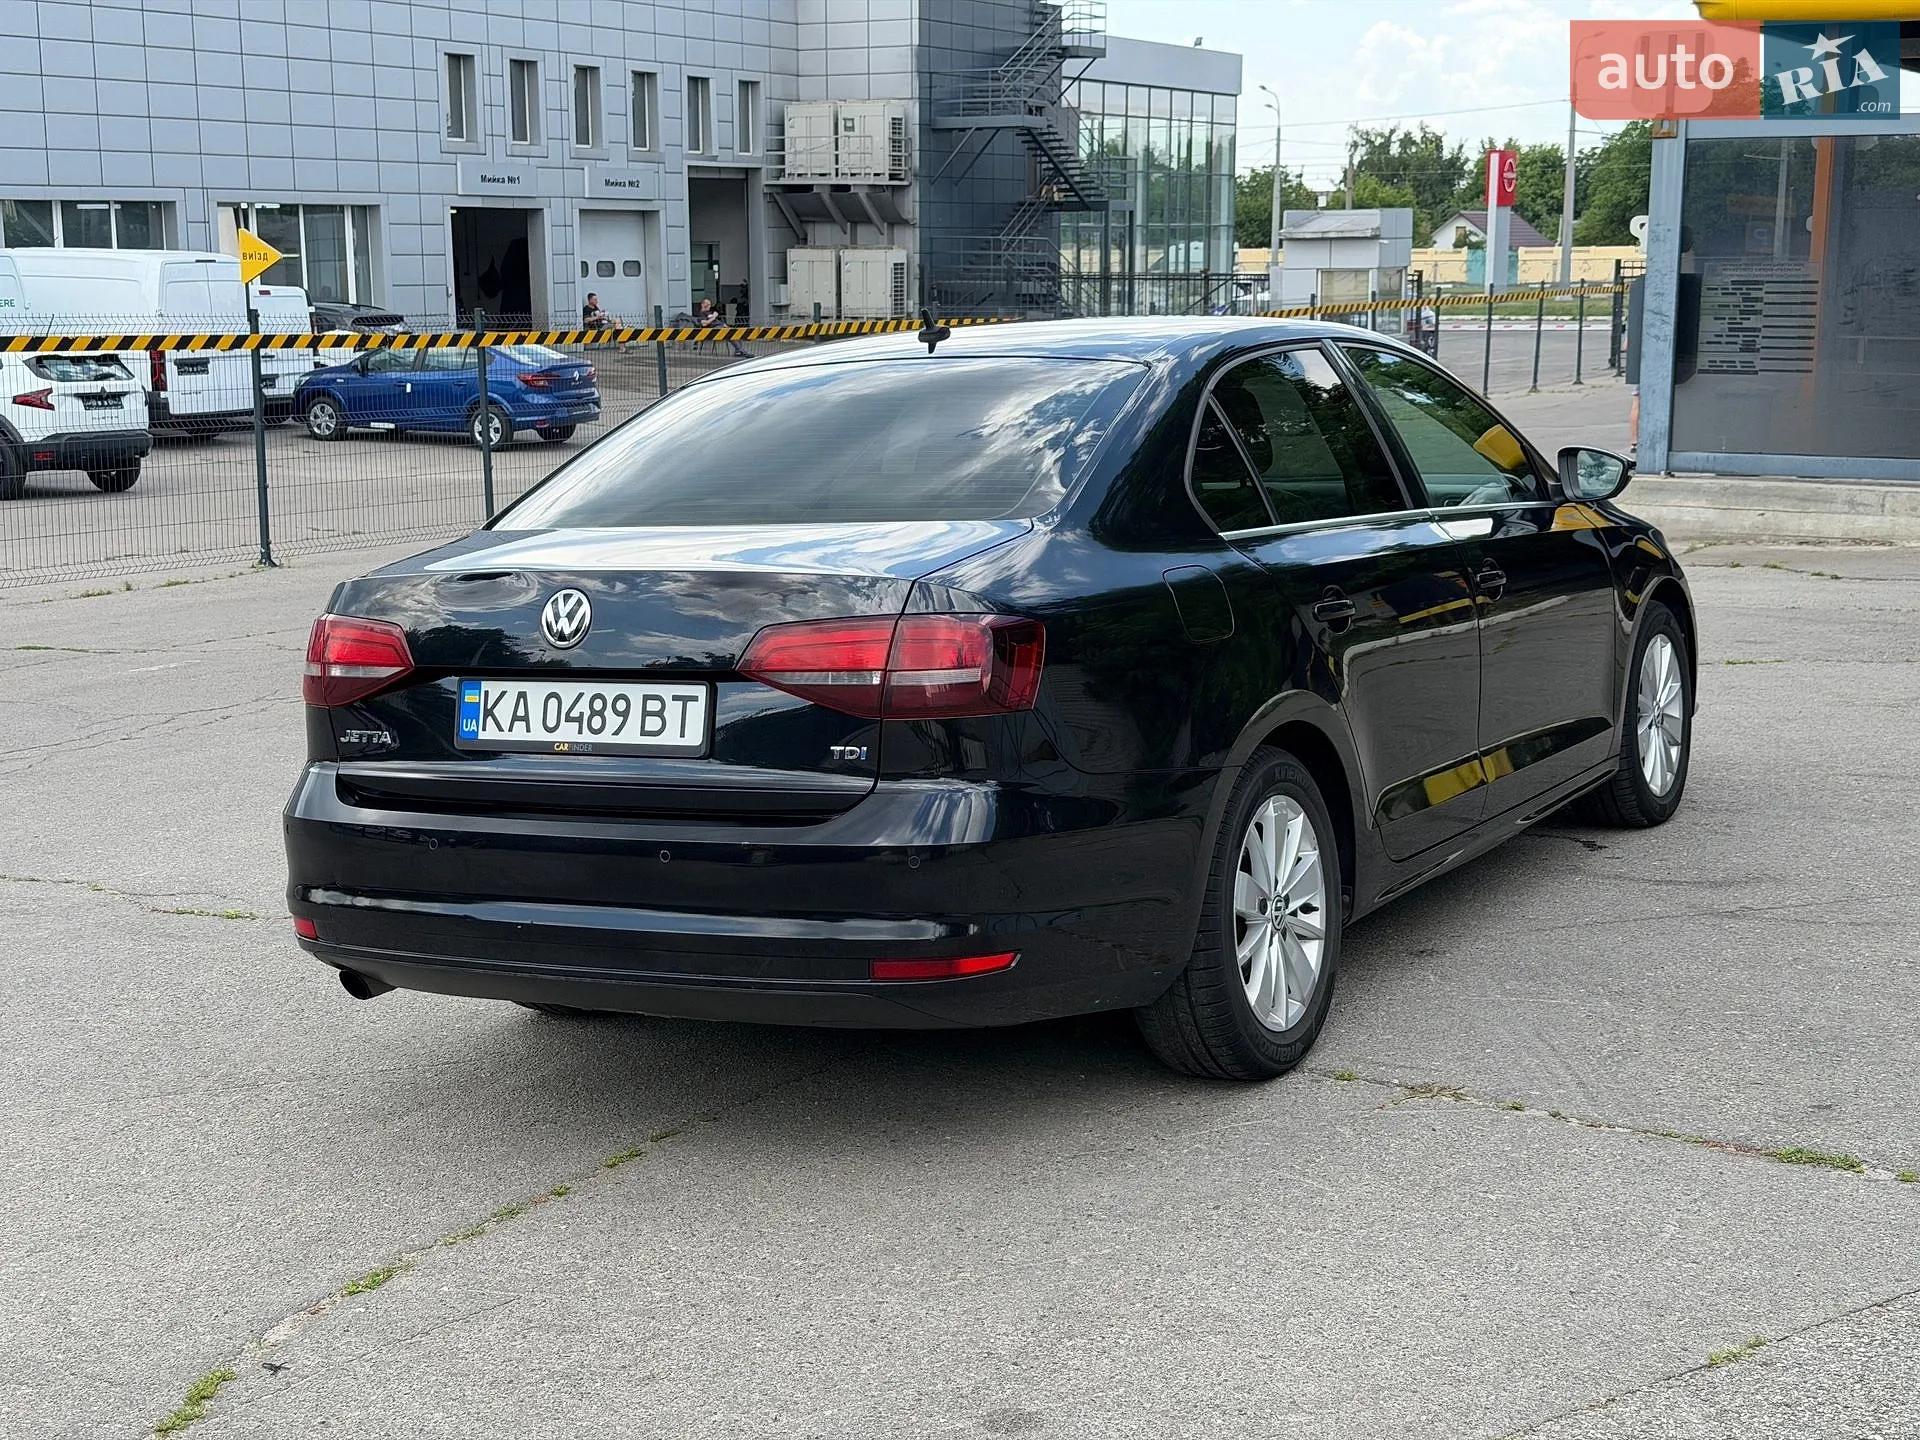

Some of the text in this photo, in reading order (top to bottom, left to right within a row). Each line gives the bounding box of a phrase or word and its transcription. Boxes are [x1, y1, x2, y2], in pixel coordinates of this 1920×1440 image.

[480, 174, 506, 185] Мийка
[481, 689, 699, 739] KA 0489 BT
[463, 719, 477, 732] UA
[339, 729, 392, 744] JETTA
[830, 745, 868, 760] TDI
